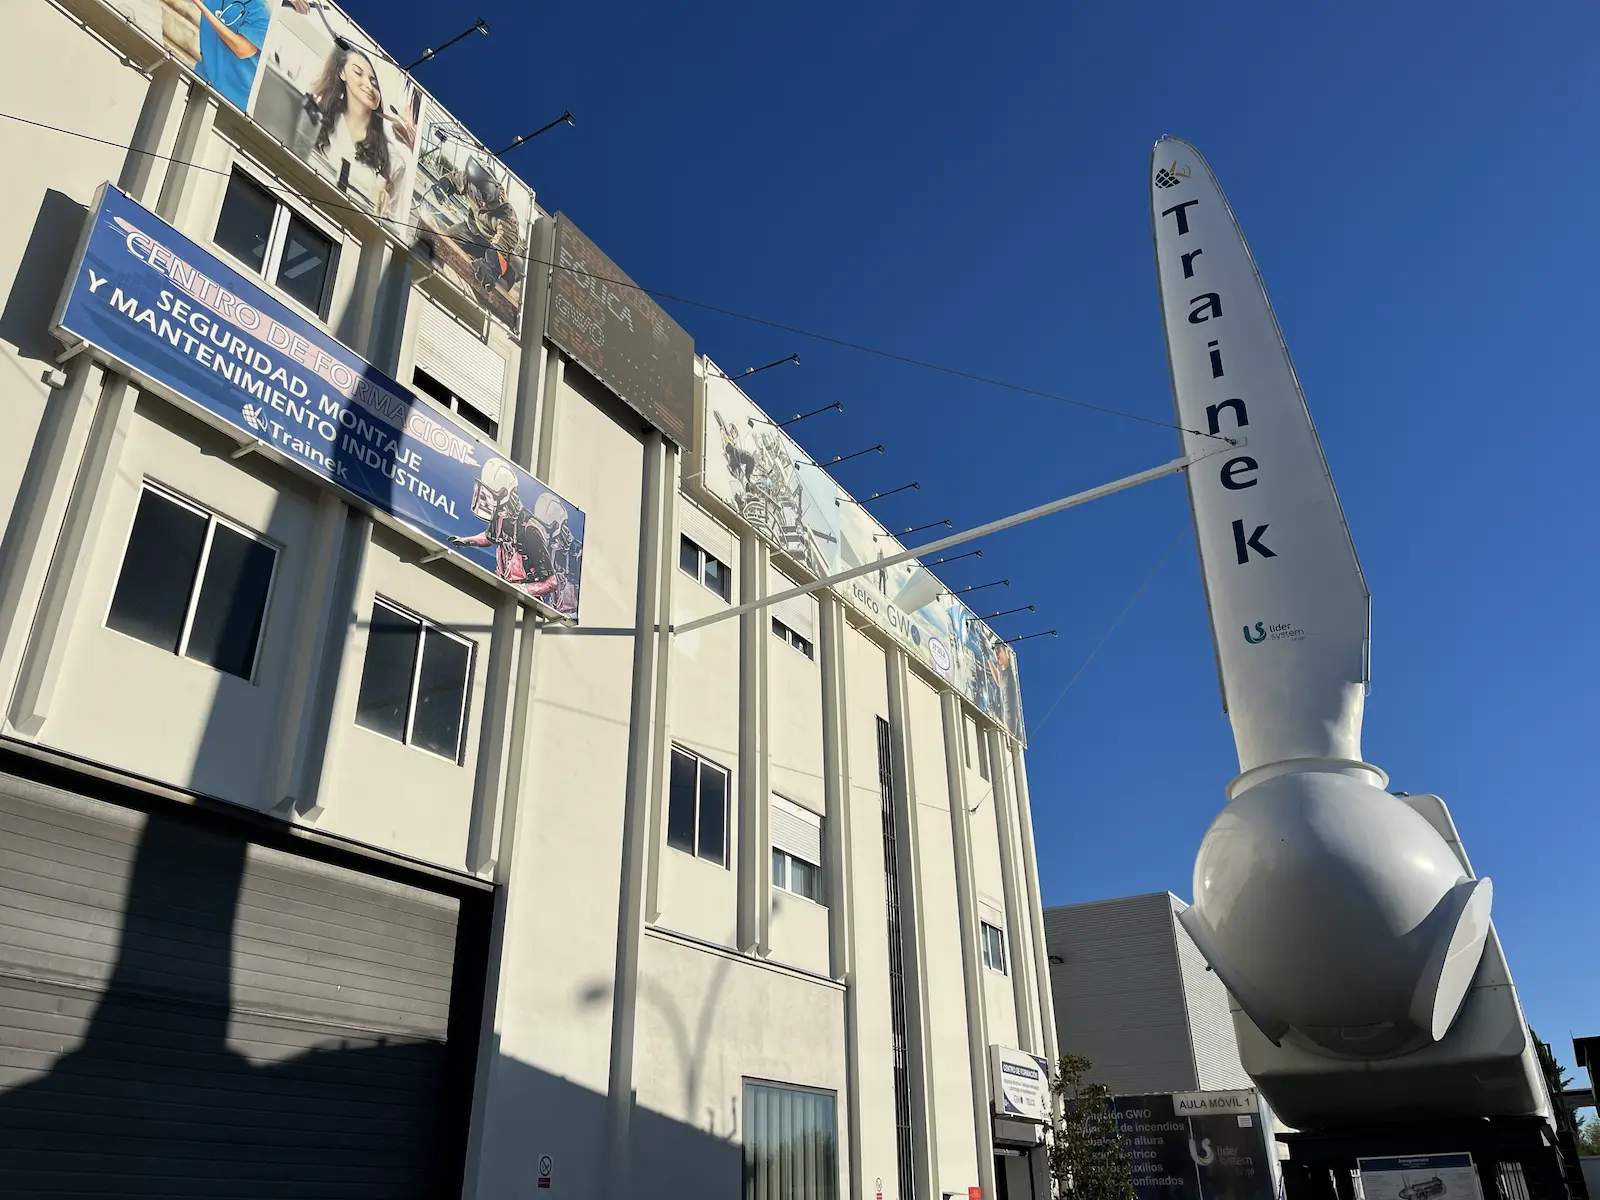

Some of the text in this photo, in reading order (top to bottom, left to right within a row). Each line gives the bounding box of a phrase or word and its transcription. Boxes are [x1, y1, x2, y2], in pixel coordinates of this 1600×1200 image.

[126, 231, 469, 464] CENTRO DE FORMACIÓN
[156, 290, 423, 473] SEGURIDAD, MONTAJE
[1162, 199, 1278, 565] Trainek
[88, 268, 460, 520] Y MANTENIMIENTO INDUSTRIAL
[269, 419, 349, 481] Trainek
[852, 583, 879, 614] telco
[1271, 628, 1305, 641] system
[1179, 1097, 1251, 1110] AULA MÓVIL 1
[1125, 1108, 1152, 1120] GWO
[1120, 1122, 1133, 1133] de
[1135, 1120, 1185, 1132] incendios
[1134, 1135, 1164, 1146] altura
[1129, 1161, 1164, 1173] uxilios
[1127, 1174, 1184, 1187] confinados
